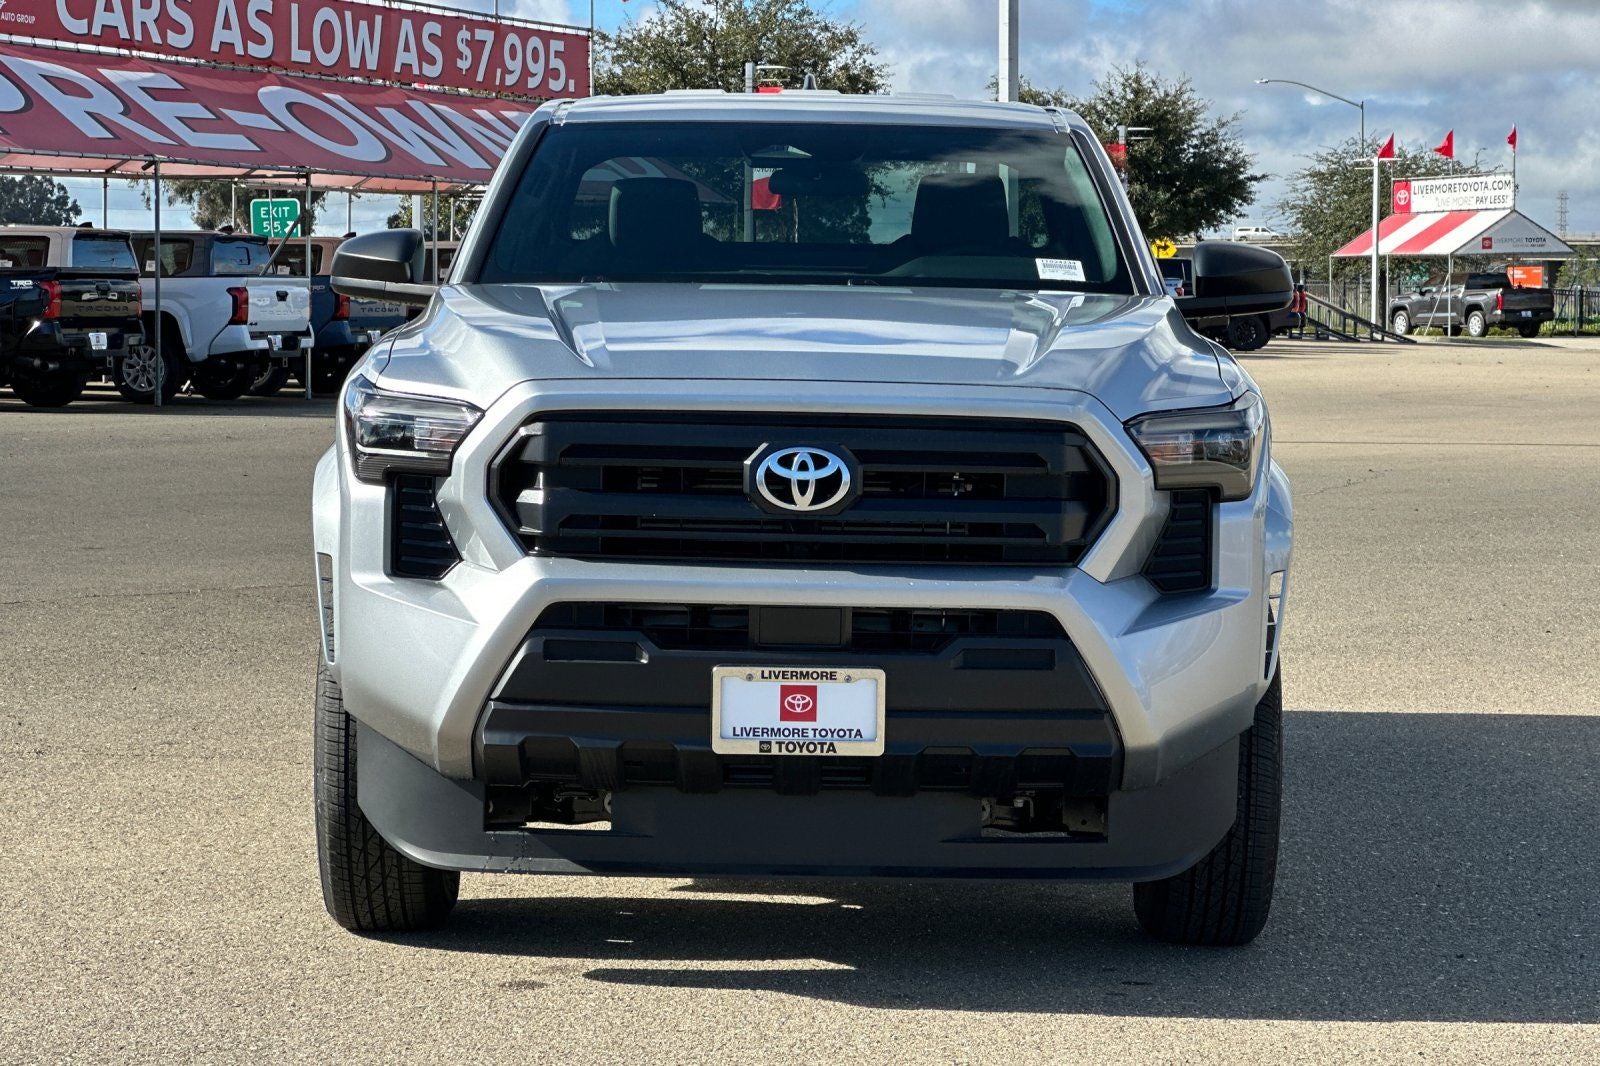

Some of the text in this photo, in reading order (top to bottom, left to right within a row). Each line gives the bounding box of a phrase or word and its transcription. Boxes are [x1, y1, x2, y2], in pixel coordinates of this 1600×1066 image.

[1, 12, 35, 24] AUTO GROUP
[56, 0, 575, 93] CARS AS LOW AS $7,995.
[0, 55, 531, 170] RE-OWN
[1413, 180, 1511, 195] LIVERMORETOYOTA.COM
[1475, 195, 1488, 204] PAY
[261, 207, 290, 218] EXIT
[760, 670, 838, 681] LIVERMORE
[732, 727, 863, 739] LIVERMORE TOYOTA
[776, 742, 837, 754] TOYOTA
